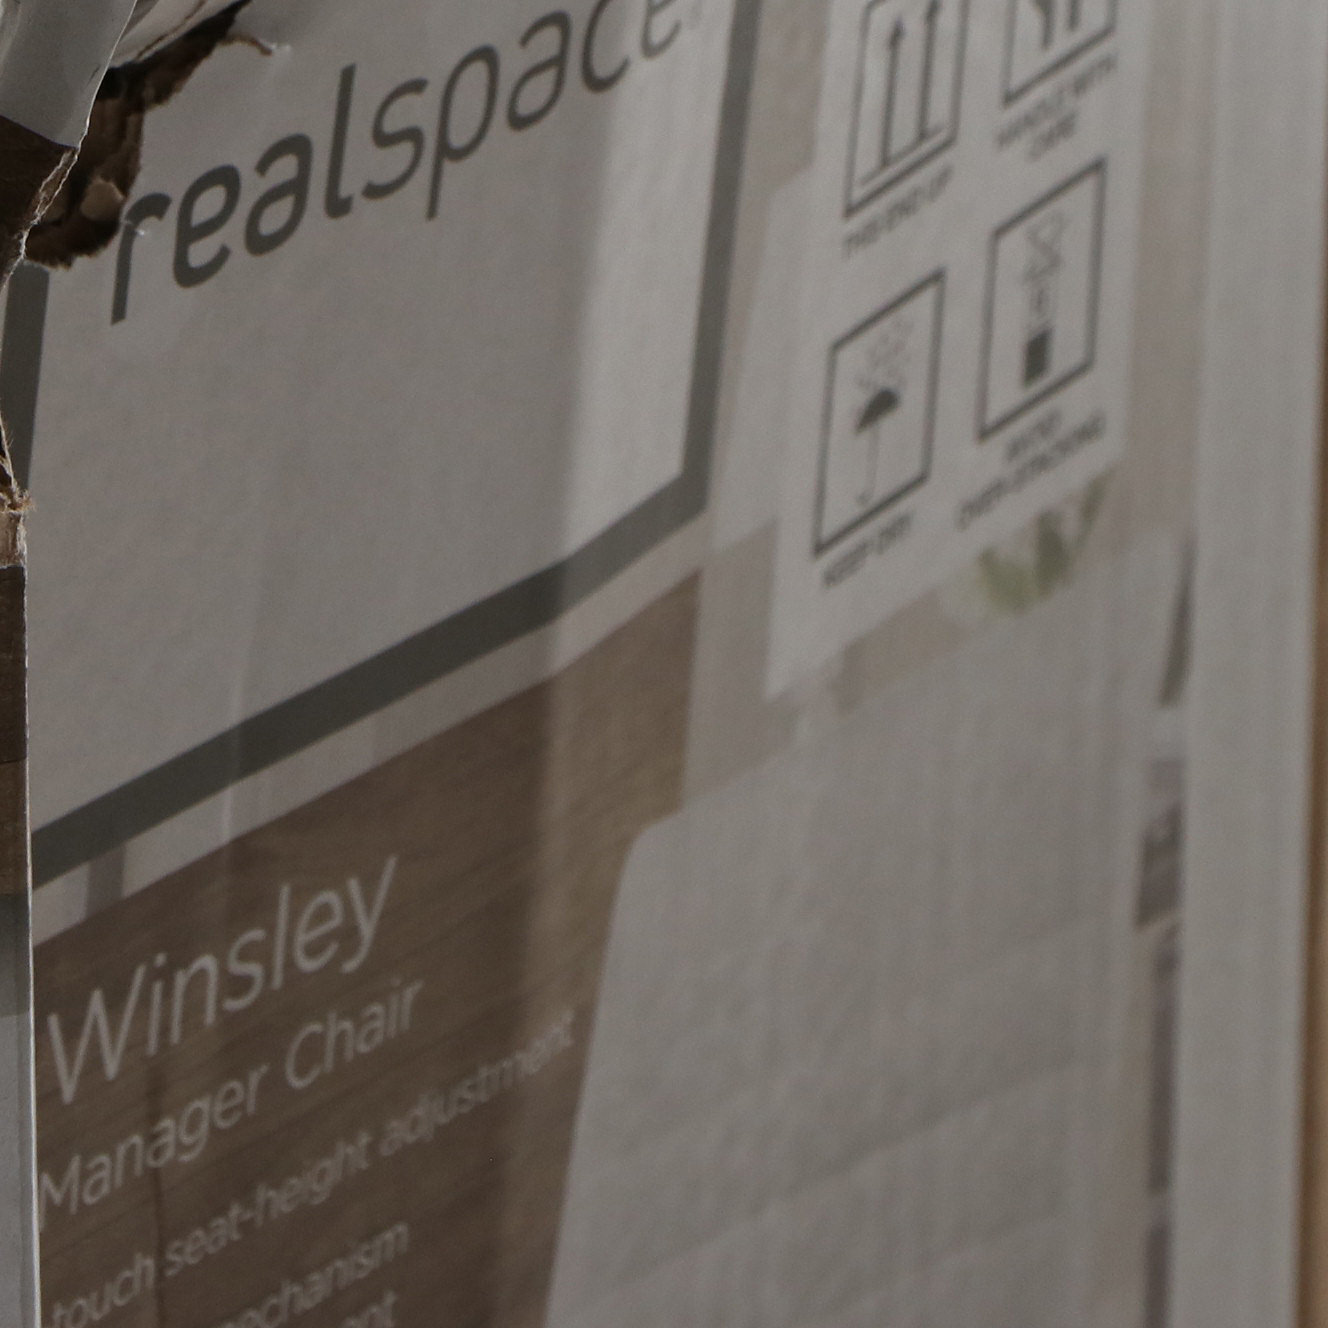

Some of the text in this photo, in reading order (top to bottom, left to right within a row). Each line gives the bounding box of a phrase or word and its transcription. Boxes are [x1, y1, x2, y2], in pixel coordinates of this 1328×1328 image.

[37, 977, 426, 1233] Manager Chair
[46, 854, 398, 1106] Winsley
[218, 1221, 411, 1328] echanism
